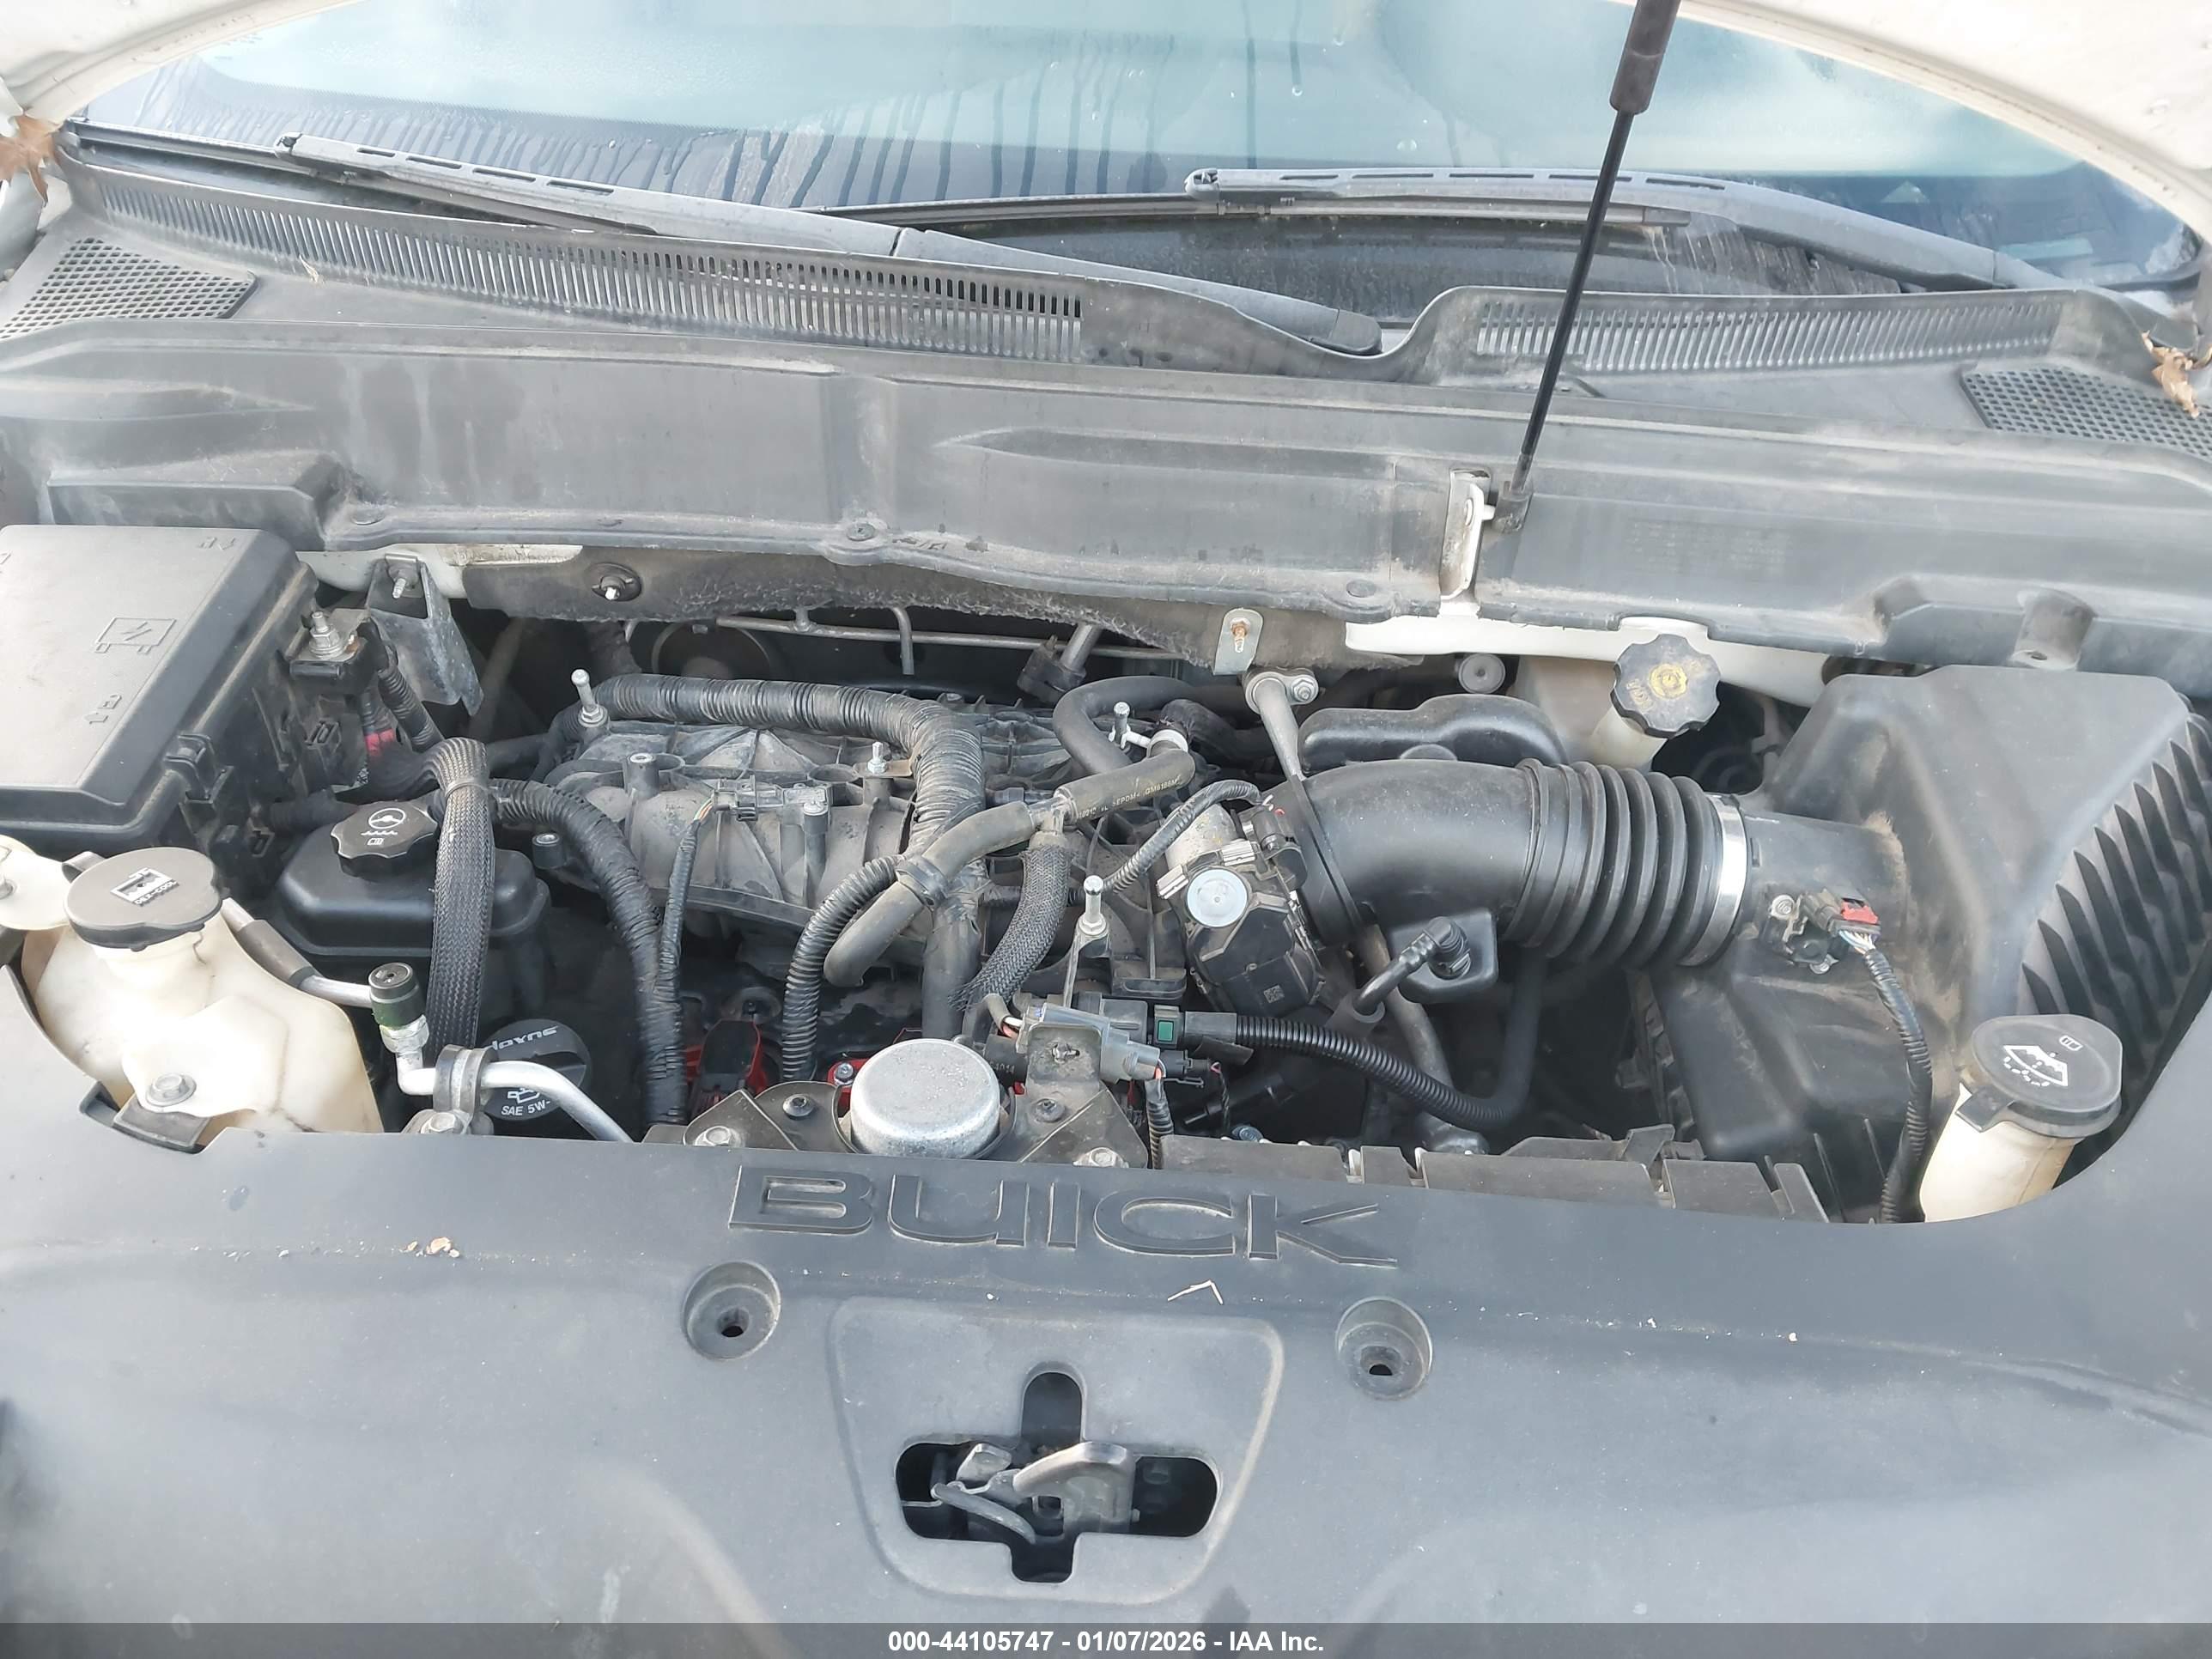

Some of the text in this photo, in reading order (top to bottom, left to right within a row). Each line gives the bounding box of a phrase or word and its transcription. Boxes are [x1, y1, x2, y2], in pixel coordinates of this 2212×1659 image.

[135, 881, 177, 904] DEX-COOL
[501, 1105, 524, 1115] SAE
[728, 1165, 1398, 1267] BUICK
